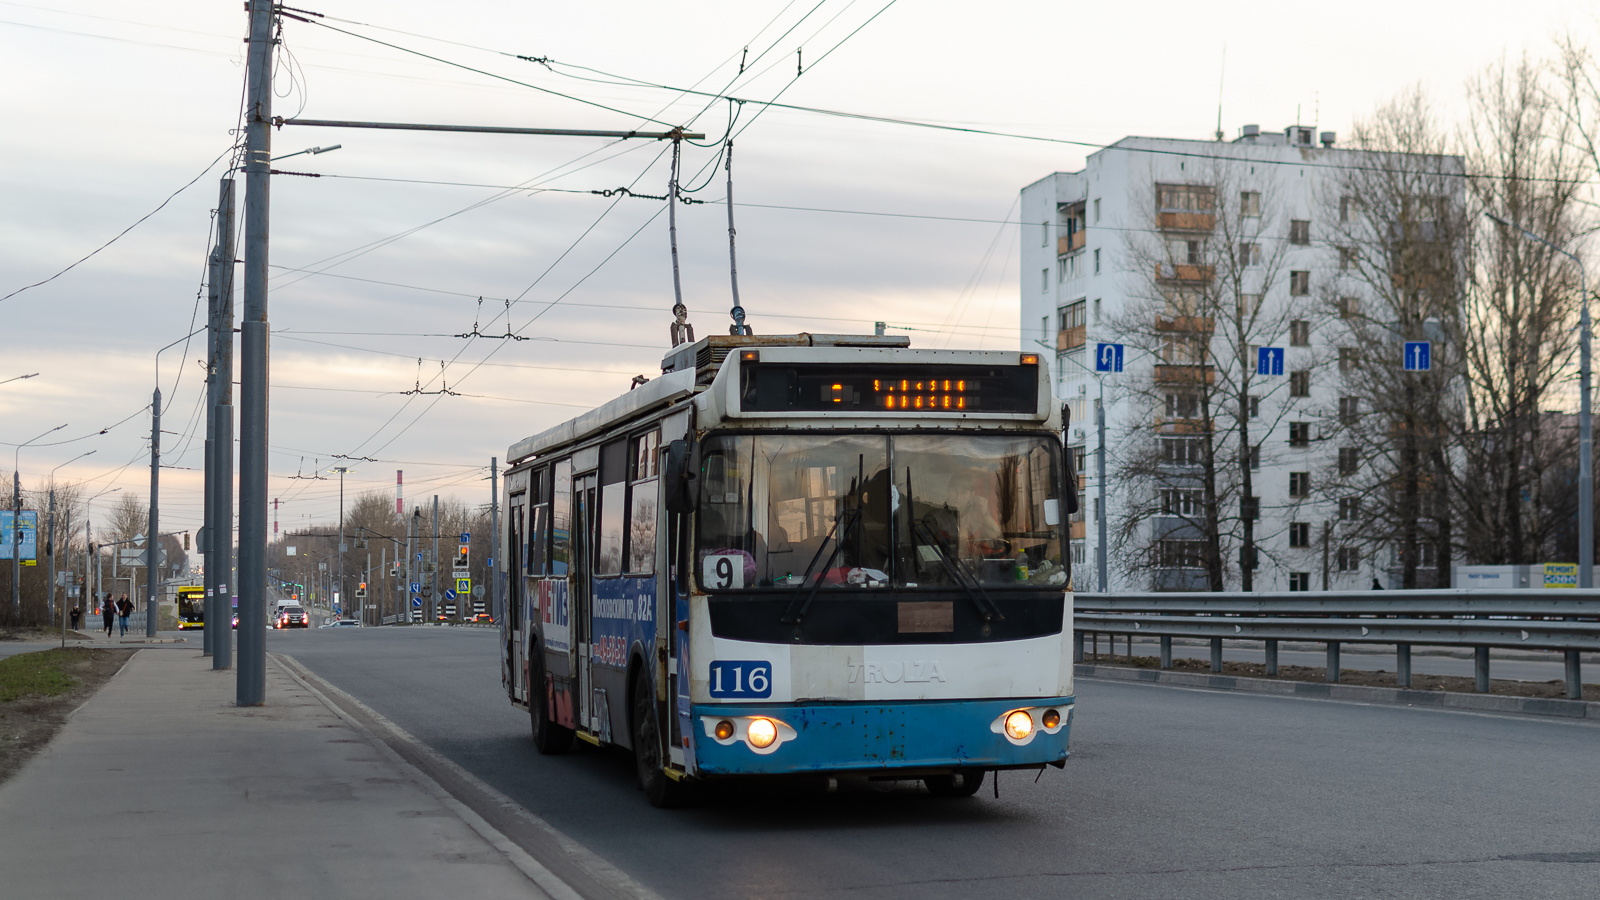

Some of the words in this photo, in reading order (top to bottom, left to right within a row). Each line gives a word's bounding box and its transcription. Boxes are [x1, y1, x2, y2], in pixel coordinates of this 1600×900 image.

[715, 557, 734, 589] 9
[1546, 565, 1575, 574] РЕМОНТ
[712, 664, 769, 692] 116
[848, 660, 946, 683] TROLZA
